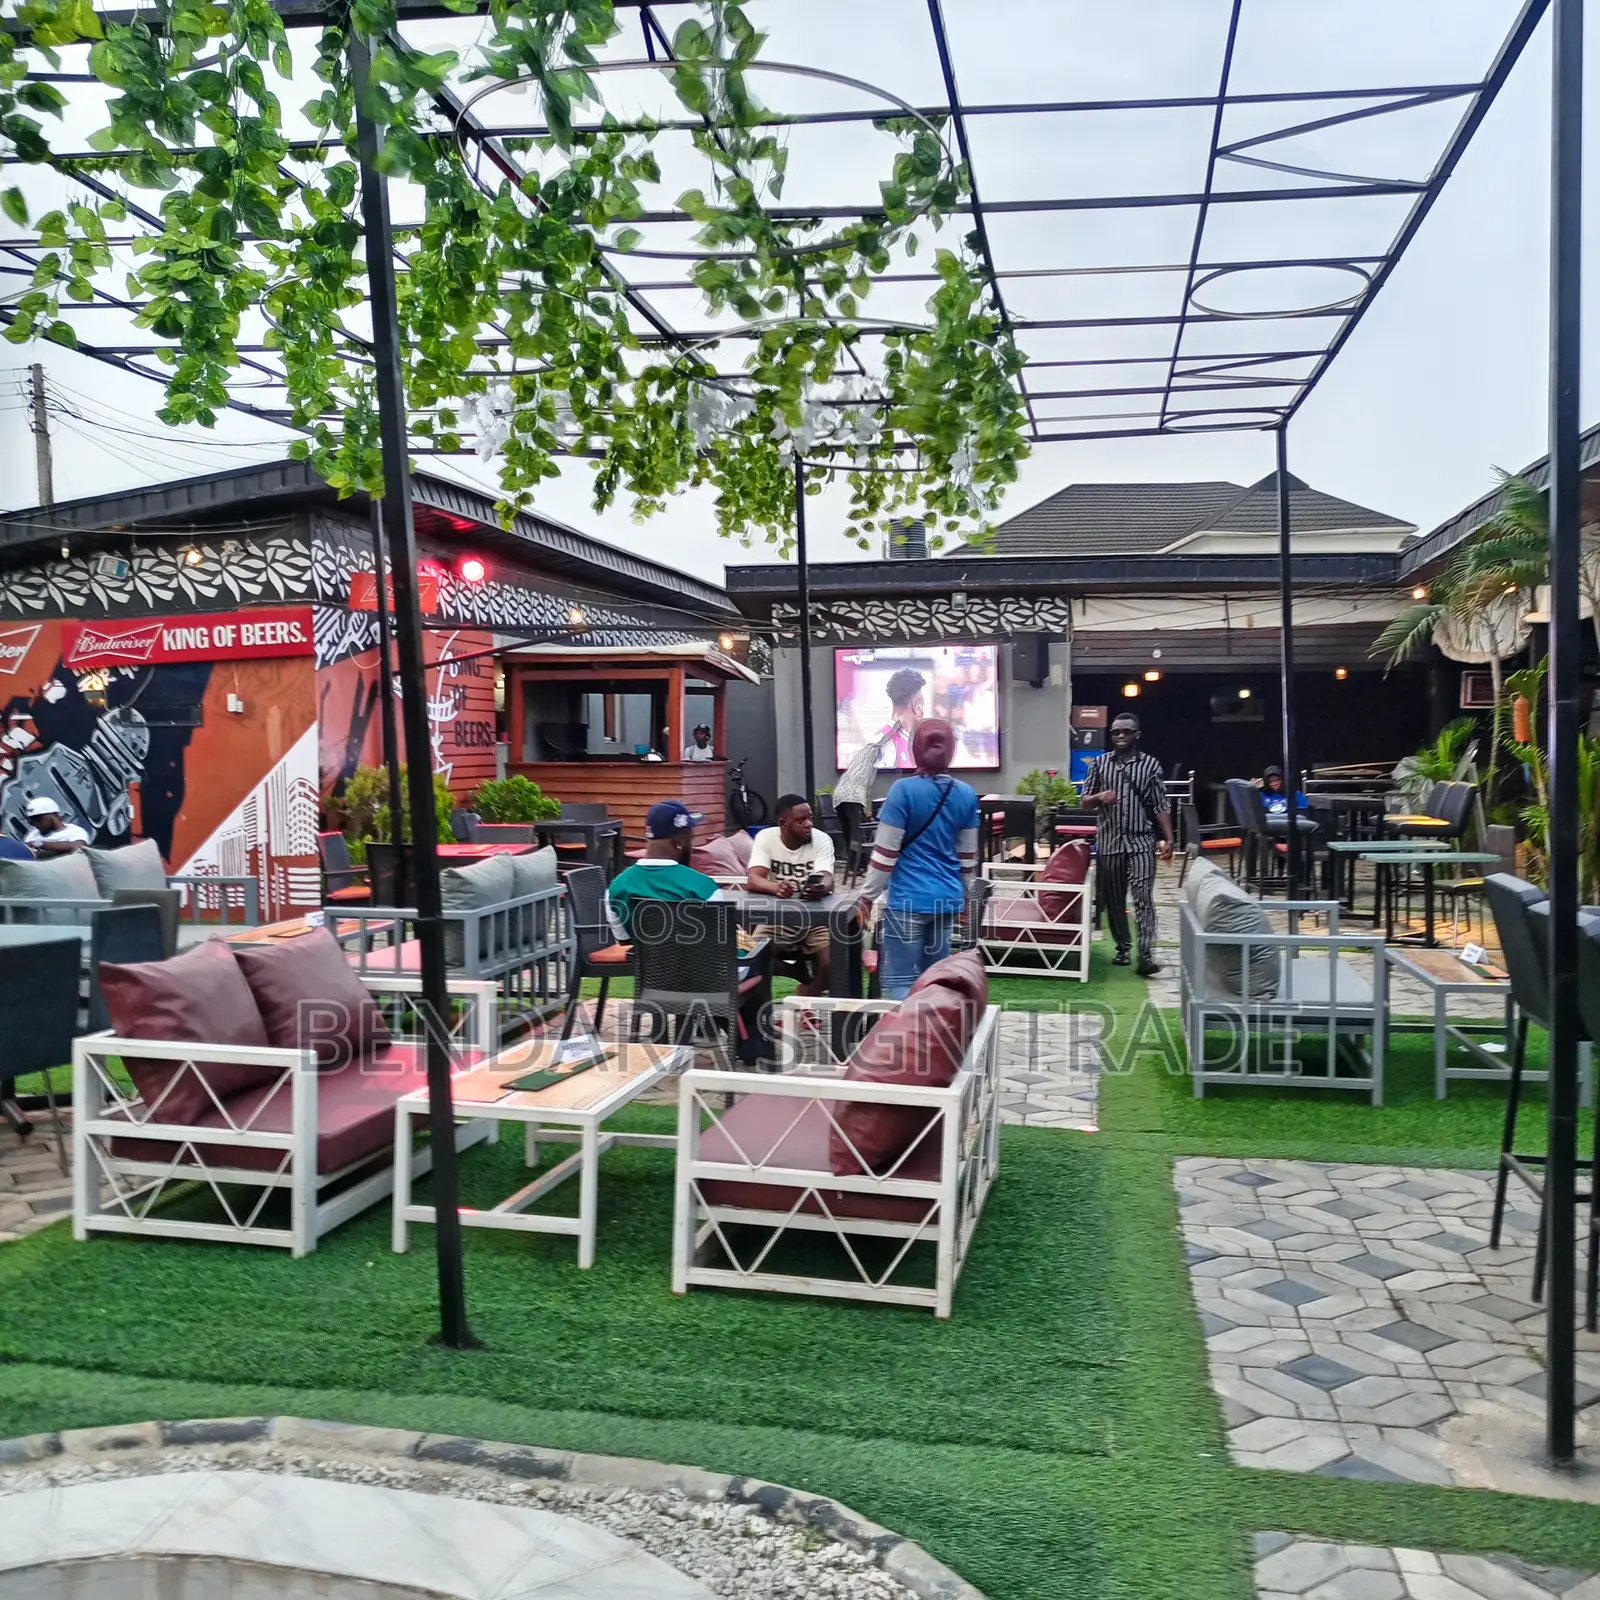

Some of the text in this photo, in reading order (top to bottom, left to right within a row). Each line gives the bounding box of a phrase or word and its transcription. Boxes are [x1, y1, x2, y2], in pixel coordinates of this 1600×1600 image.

[76, 621, 308, 653] Budweiser KING OF BEERS.
